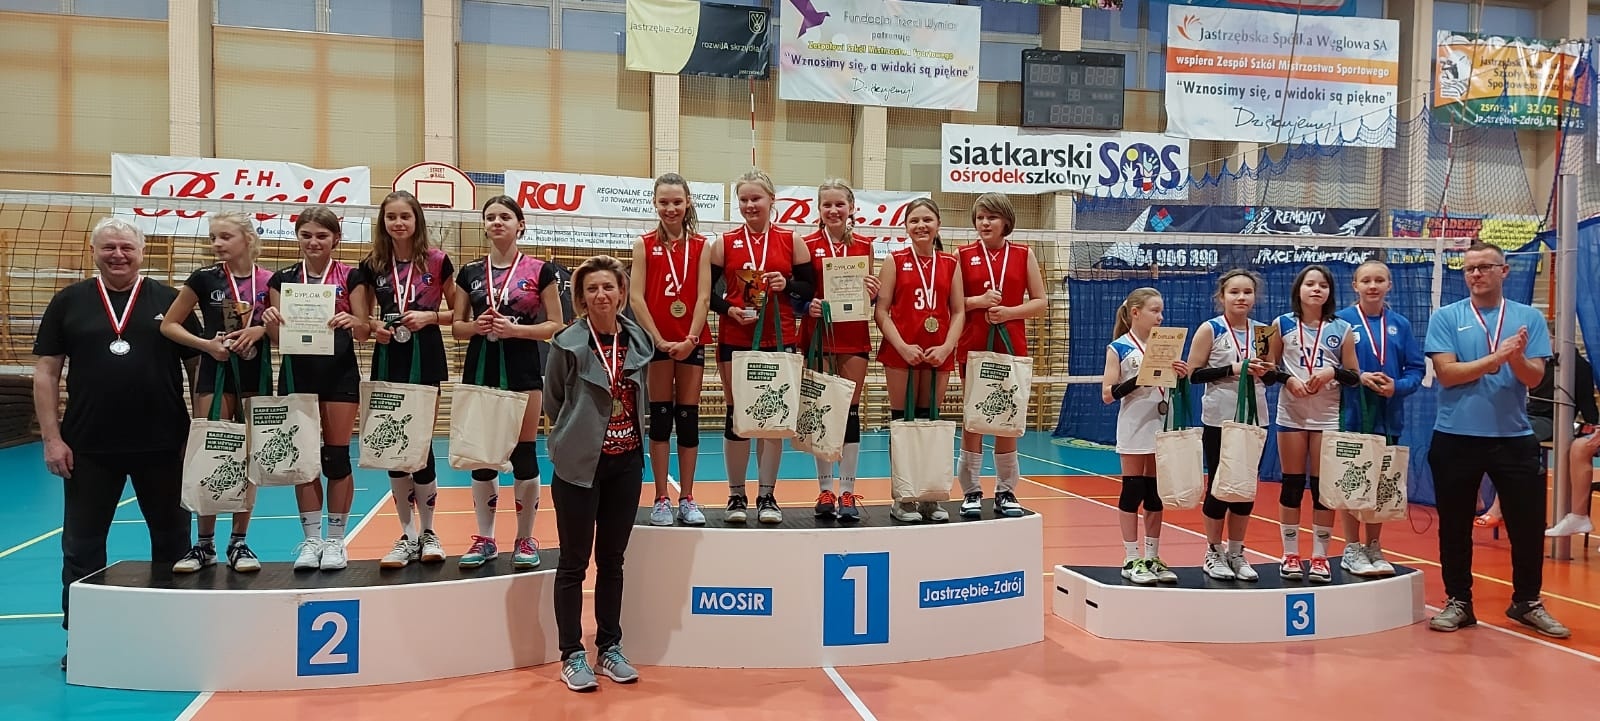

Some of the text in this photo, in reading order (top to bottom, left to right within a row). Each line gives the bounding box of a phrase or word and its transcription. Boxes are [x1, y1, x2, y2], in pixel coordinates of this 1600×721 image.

[1199, 27, 1269, 45] Jastrzębska
[1317, 36, 1370, 52] Węglowa
[1372, 39, 1388, 51] SA
[848, 60, 868, 73] się,
[870, 64, 877, 72] a
[881, 62, 916, 74] widoki
[919, 66, 932, 79] są
[1176, 55, 1389, 77] wspiera Zespół Szkół Mistrzostwa Sportowego
[1249, 87, 1271, 102] się,
[1274, 90, 1282, 98] a
[1286, 89, 1326, 101] widoki
[1329, 93, 1344, 107] są
[1527, 104, 1540, 114] 32
[949, 138, 1092, 169] siatkarski
[234, 169, 281, 188] F.H.
[950, 167, 1092, 188] ośrodekszkolny
[516, 180, 586, 212] RCU
[597, 187, 641, 197] REGIONALNE
[1273, 209, 1326, 225] REMONTY
[842, 565, 868, 635] 1
[923, 577, 1022, 603] Jastrzębie-Zdrój
[699, 591, 765, 611] MOSiR
[1292, 600, 1310, 630] 3
[309, 611, 348, 665] 2
